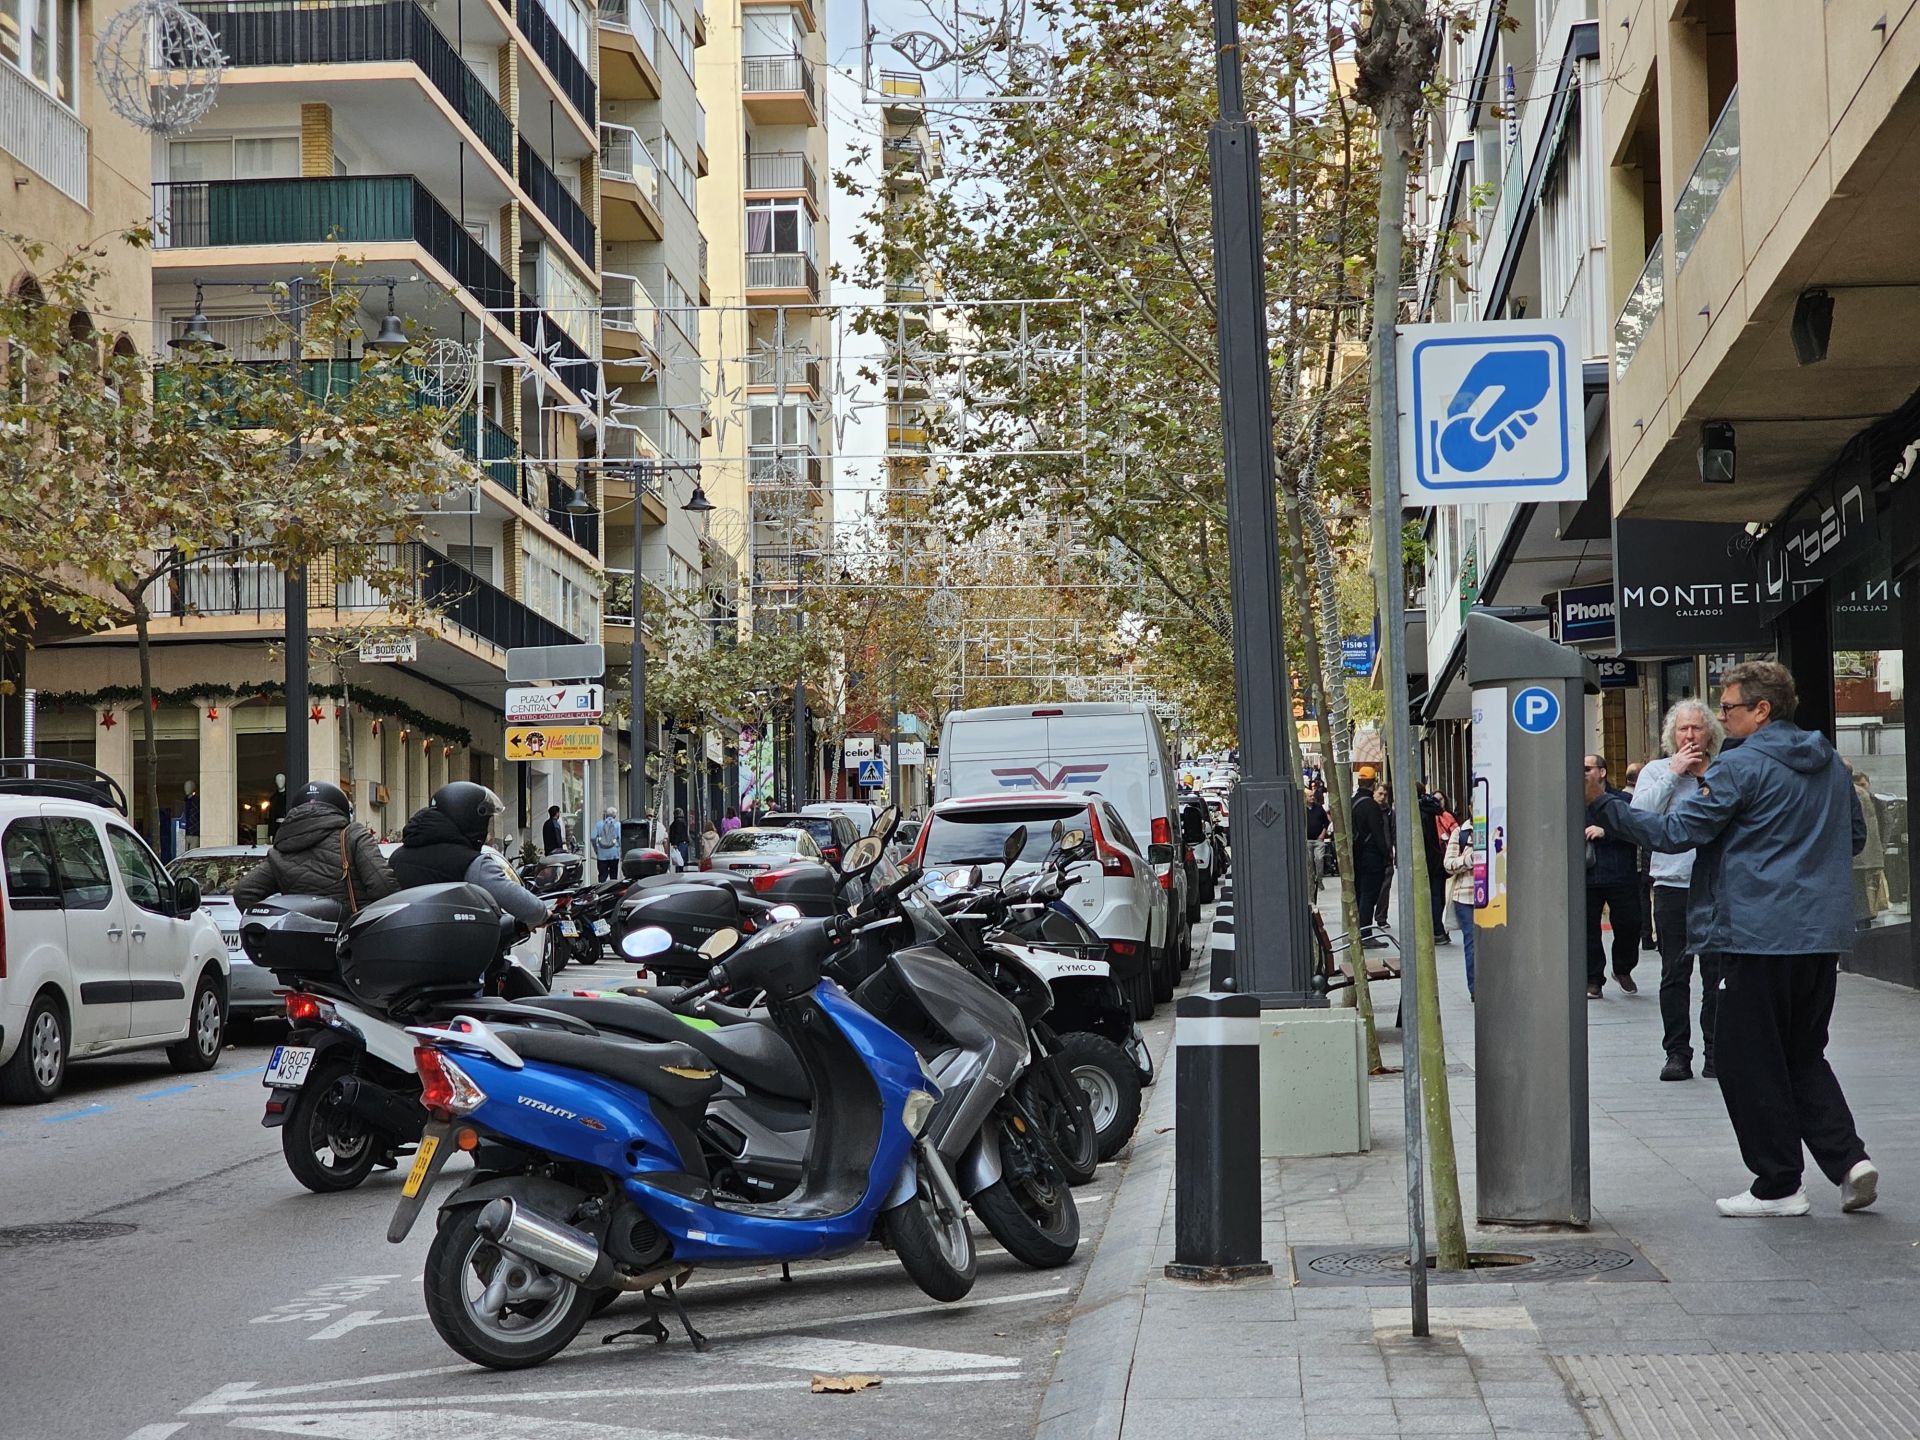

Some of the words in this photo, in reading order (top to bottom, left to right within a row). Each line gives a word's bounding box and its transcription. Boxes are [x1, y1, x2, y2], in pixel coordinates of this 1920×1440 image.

[1766, 484, 1864, 596] urban
[1675, 608, 1724, 617] CALZADOS
[375, 644, 411, 654] BODEGON
[520, 695, 545, 704] PLAZA
[510, 703, 552, 714] CENTRAL
[1526, 695, 1549, 725] P
[845, 748, 870, 758] celio
[1057, 964, 1096, 972] KYMCO
[281, 1050, 311, 1066] 0805
[276, 1064, 303, 1080] MSF
[517, 1095, 577, 1120] VITALITY
